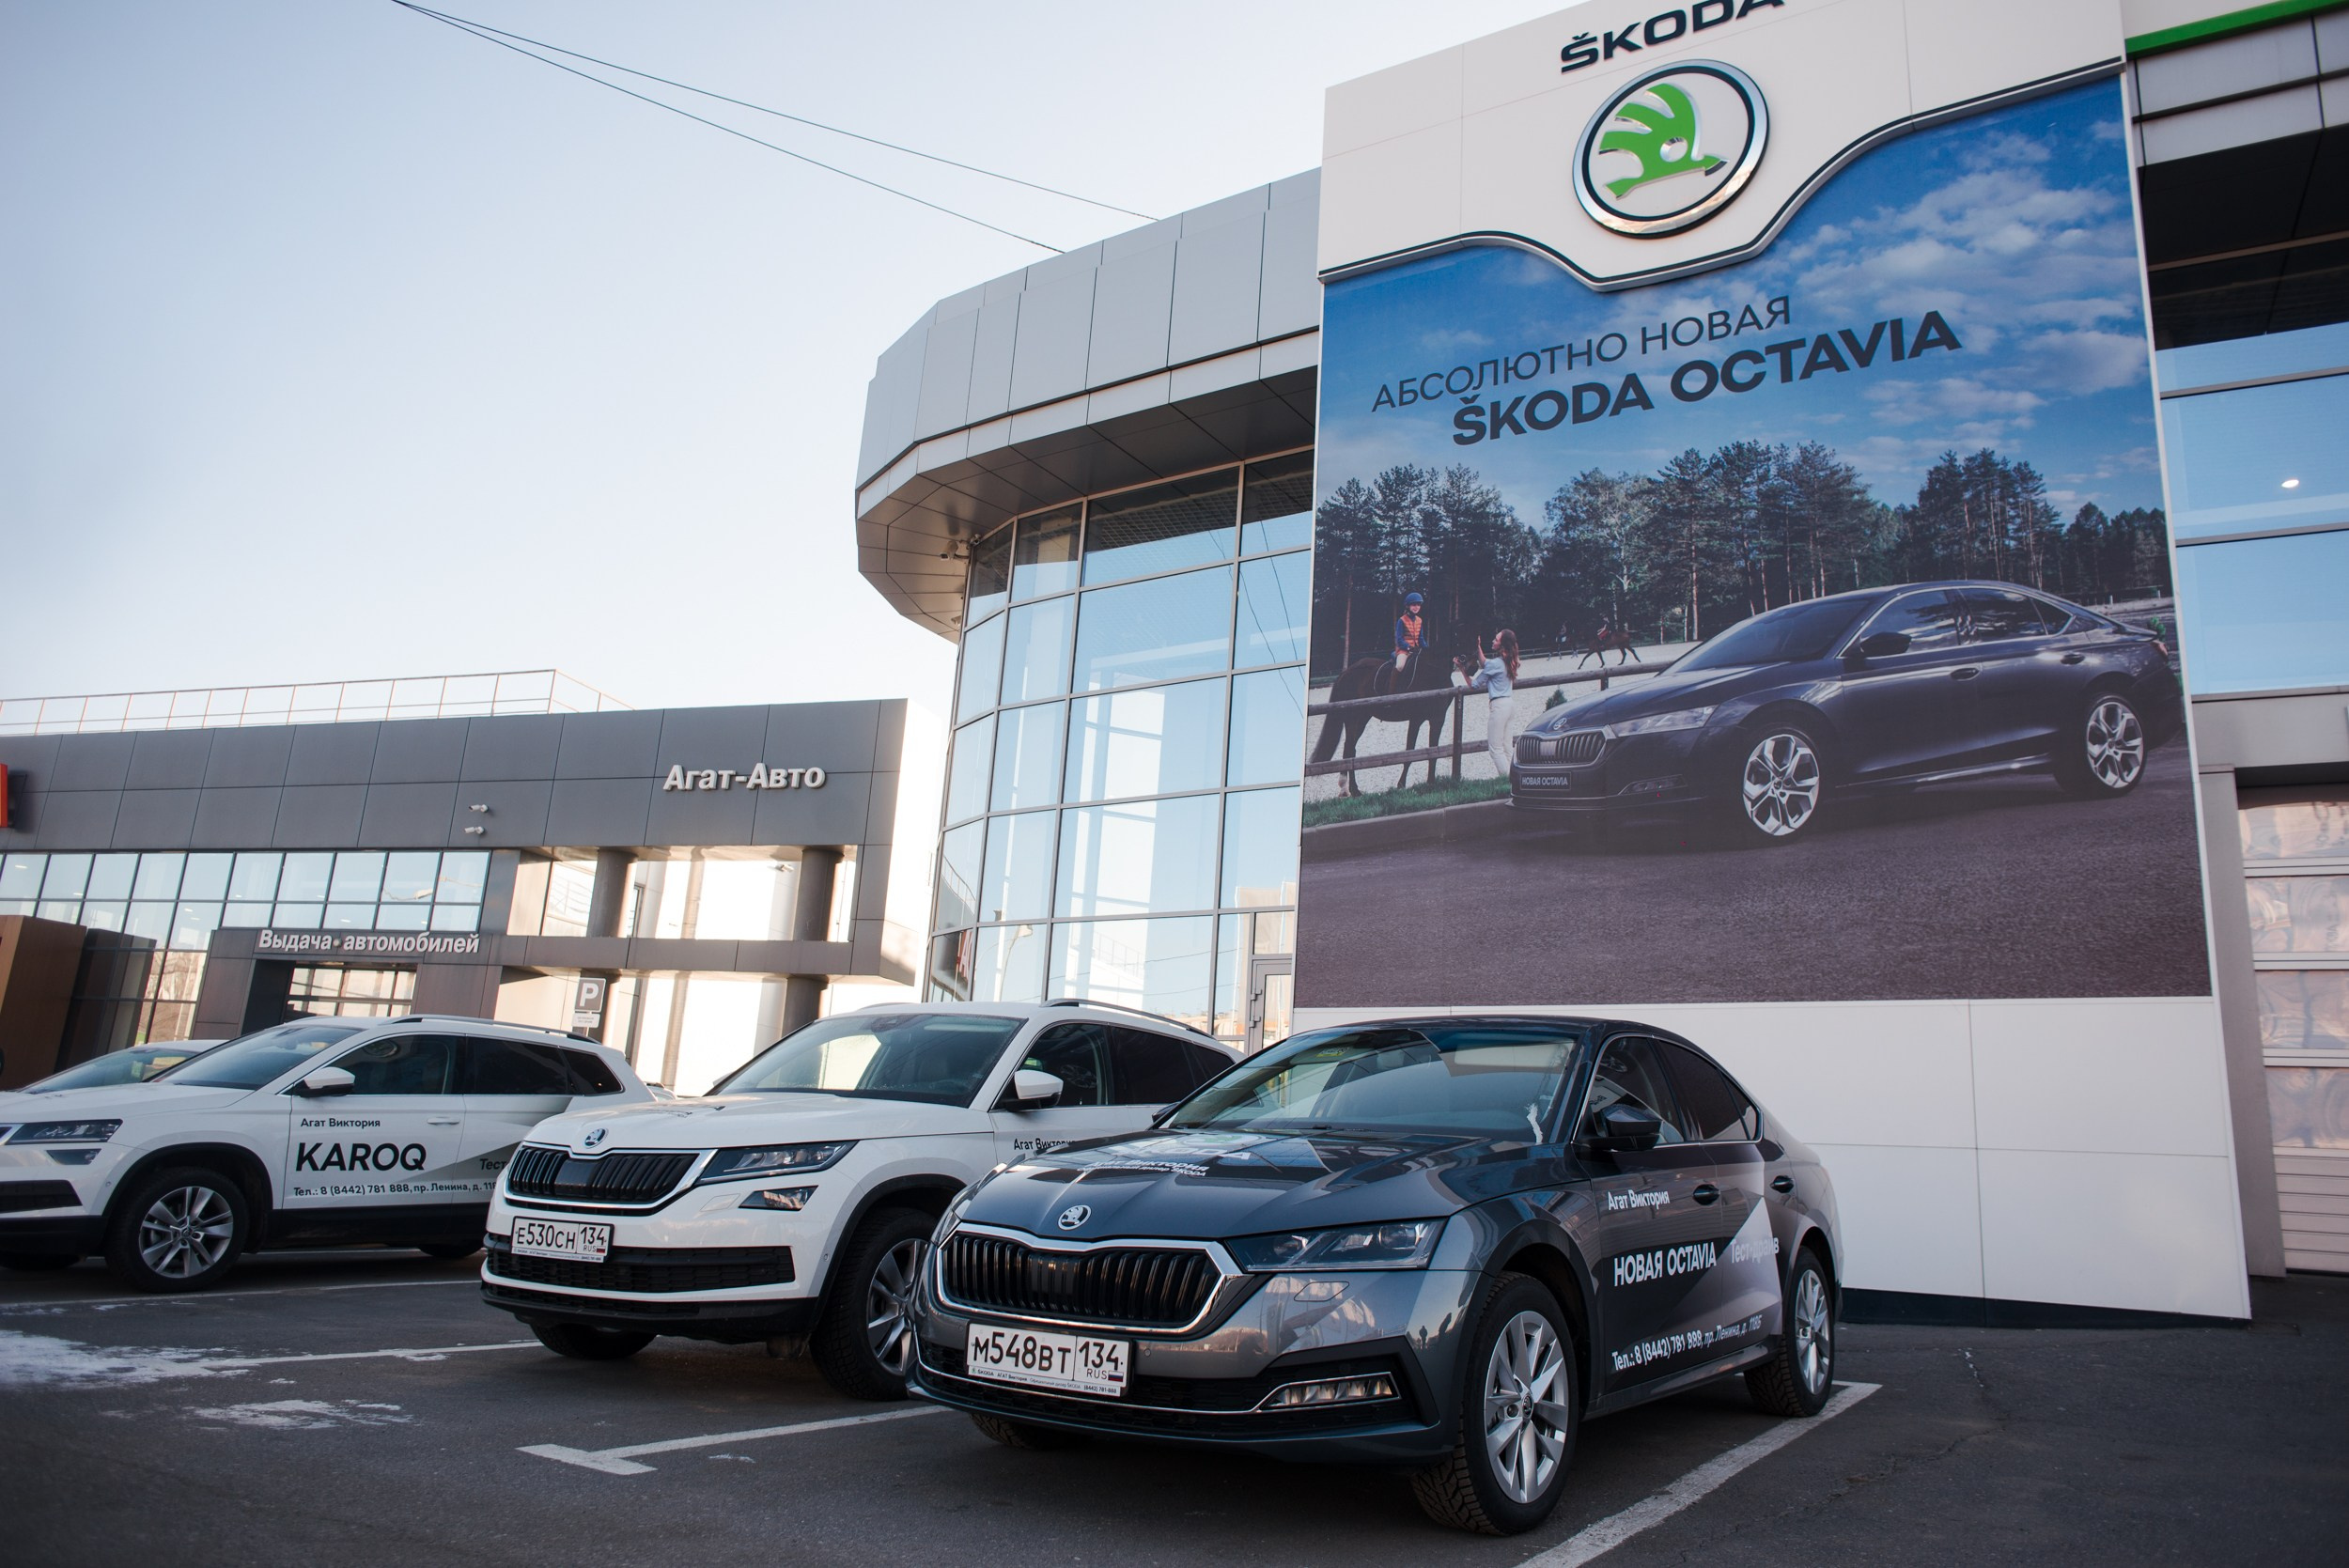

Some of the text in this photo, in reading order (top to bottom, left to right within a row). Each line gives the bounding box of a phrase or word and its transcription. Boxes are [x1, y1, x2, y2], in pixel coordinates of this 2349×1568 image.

[1371, 294, 1792, 413] АБСОЛЮТНО НОВАЯ
[1452, 309, 1963, 447] ŠKODA OCTAVIA
[662, 762, 827, 791] Агат-Авто
[1522, 777, 1568, 785] НОВАЯ OCTAVIA
[258, 929, 480, 954] Выдача автомобилей
[580, 983, 599, 1007] P
[301, 1118, 381, 1128] Агат Виктория
[295, 1142, 427, 1172] KAROQ
[1014, 1138, 1076, 1150] Агат Викто
[293, 1188, 319, 1196] Тел.:
[320, 1187, 328, 1195] 8
[330, 1186, 366, 1196] (8442)
[367, 1185, 385, 1193] 781
[389, 1184, 412, 1193] 888,
[413, 1185, 429, 1193] пр.
[431, 1183, 471, 1191] Ленина,
[1608, 1189, 1670, 1210] Агат Виктория
[517, 1222, 576, 1250] Е530СН
[581, 1226, 604, 1246] 134
[1613, 1241, 1718, 1287] НОВАЯ OCTAVIA
[973, 1331, 1071, 1374] М548ВТ
[1079, 1341, 1119, 1371] 134
[1612, 1350, 1635, 1371] Тел.:
[1634, 1345, 1642, 1364] 8
[1642, 1337, 1671, 1366] (8442)
[1671, 1334, 1686, 1354] 781
[1687, 1329, 1703, 1349] 888,
[1086, 1368, 1107, 1380] RUS
